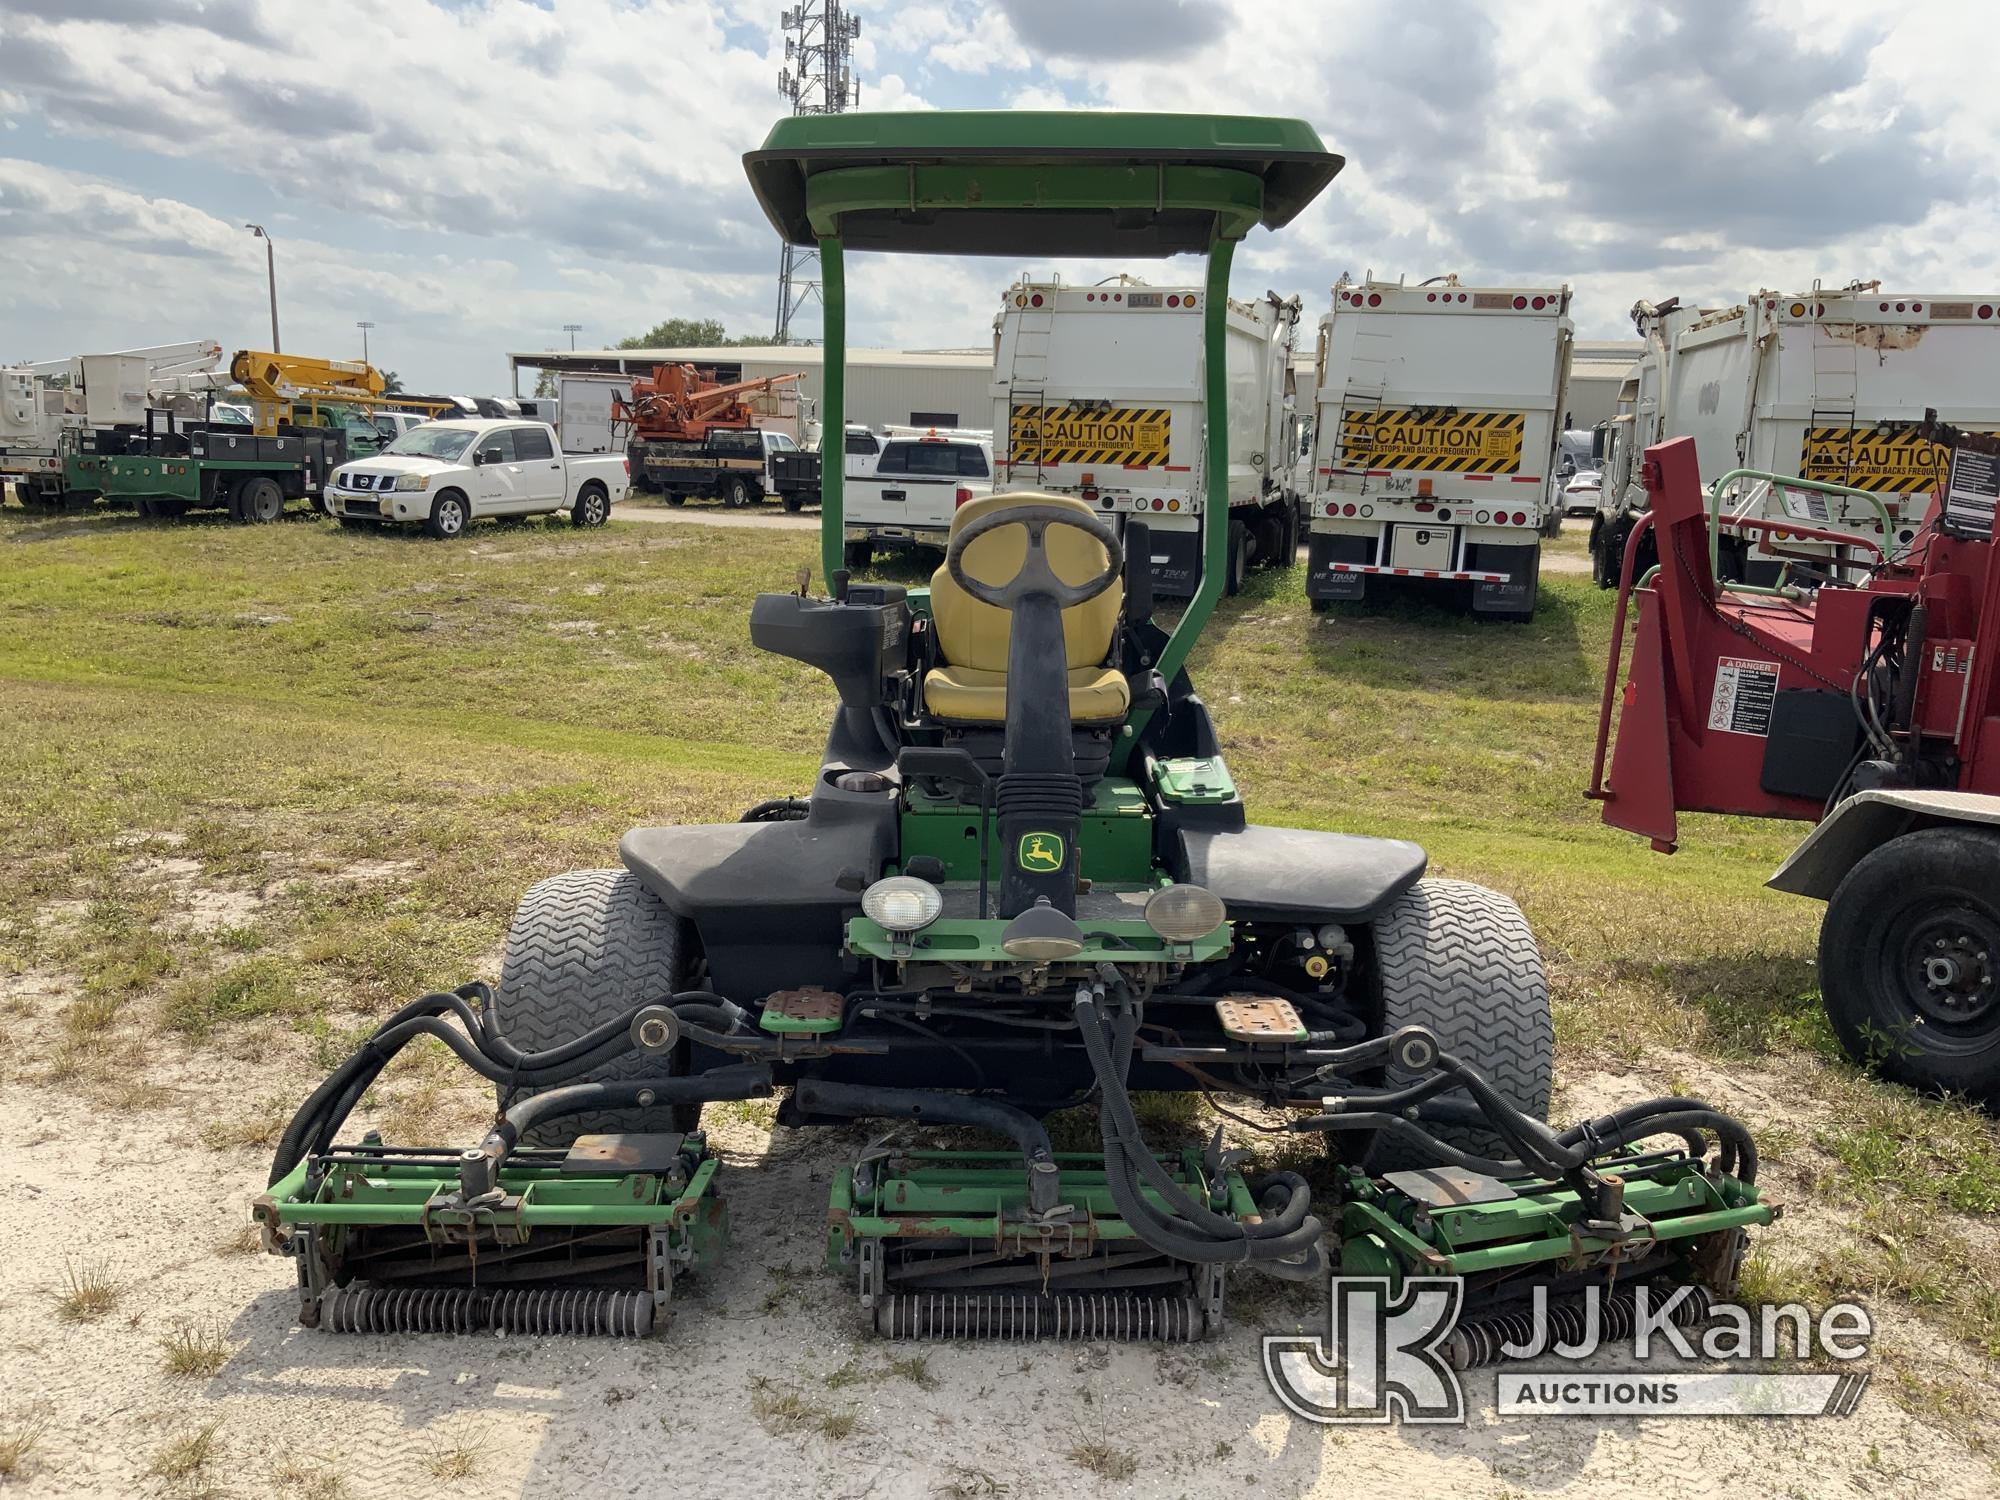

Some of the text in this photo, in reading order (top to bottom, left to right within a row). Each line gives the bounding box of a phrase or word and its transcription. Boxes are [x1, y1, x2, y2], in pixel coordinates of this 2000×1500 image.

[1042, 423, 1134, 441] CAUTION
[1375, 427, 1482, 447] CAUTION
[1098, 441, 1135, 449] FREQUENTLY
[1440, 447, 1482, 456] FREQUENTLY
[1837, 446, 1950, 466] CAUTION
[1841, 466, 1865, 474] SOPS
[1866, 466, 1880, 474] AND
[1883, 467, 1906, 475] BACKS
[1908, 467, 1950, 476] FREQUENTL
[1735, 660, 1771, 671] DANGER
